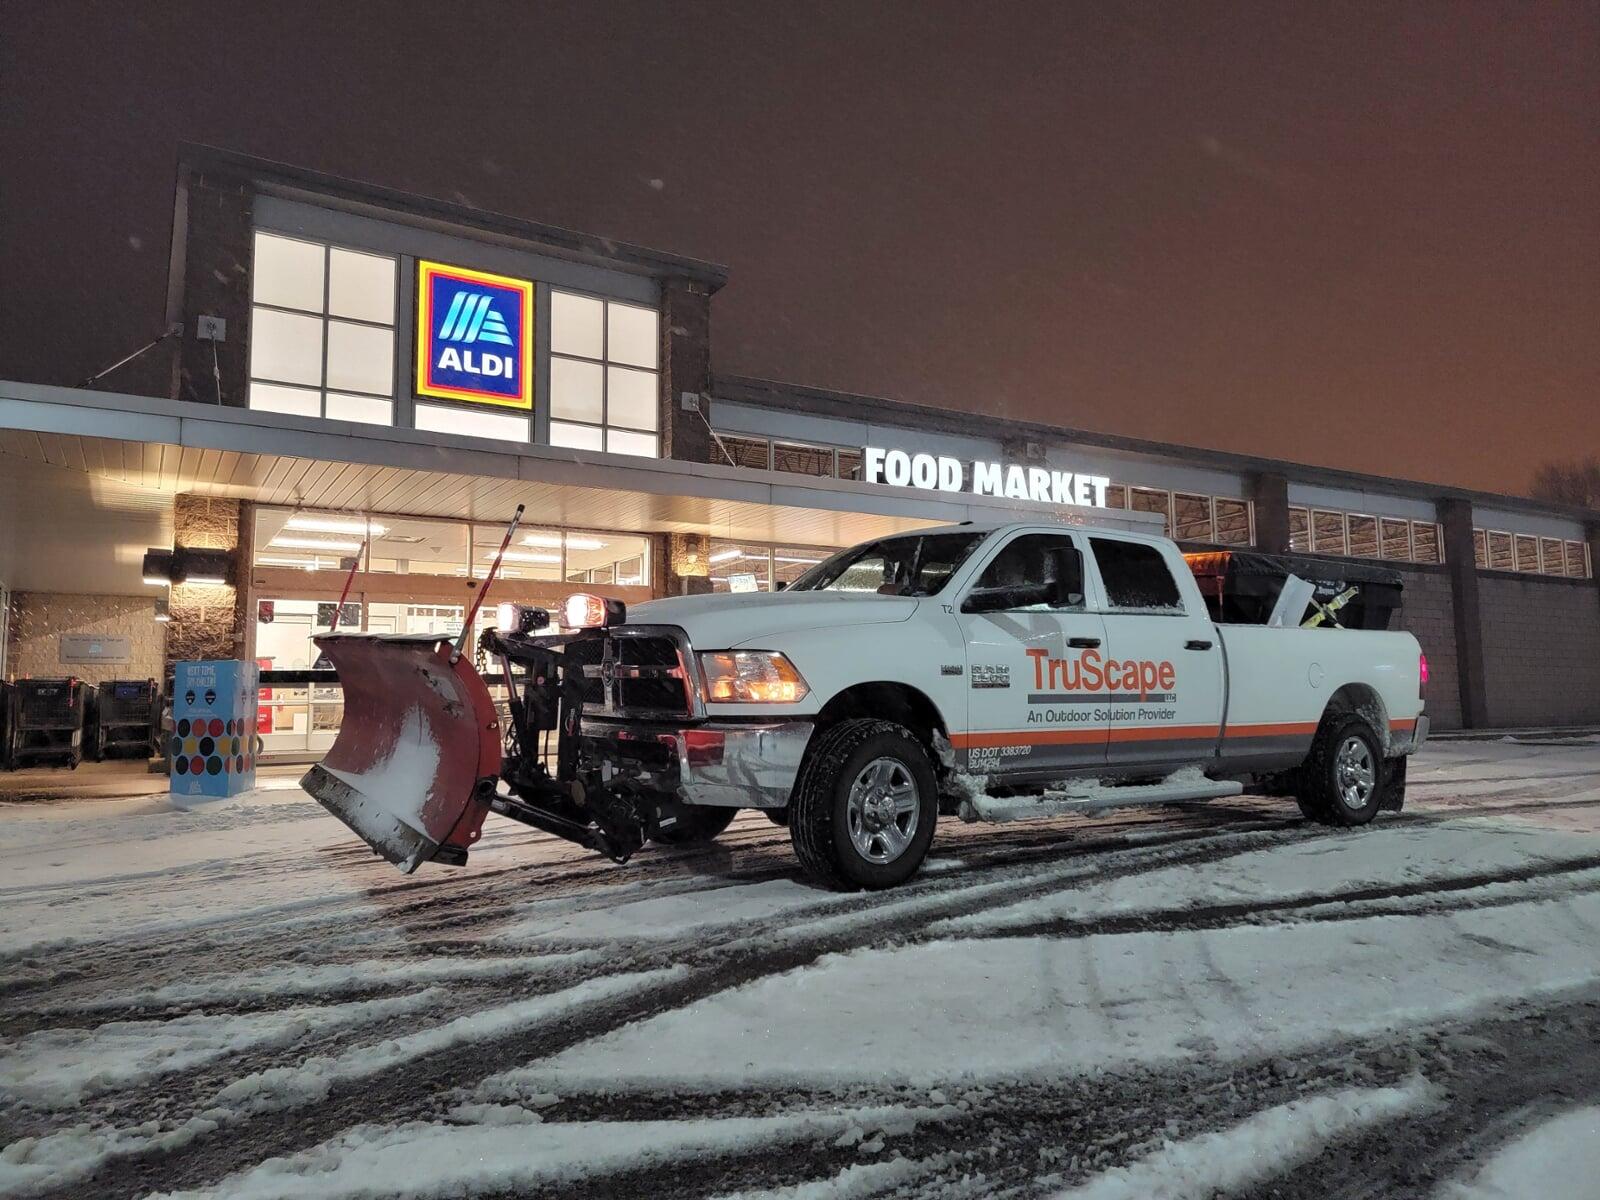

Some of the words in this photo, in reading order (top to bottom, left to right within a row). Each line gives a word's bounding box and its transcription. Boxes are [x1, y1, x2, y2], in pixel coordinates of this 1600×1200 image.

[438, 347, 513, 379] ALDI
[864, 447, 963, 492] FOOD
[972, 460, 1111, 509] MARKET
[941, 604, 954, 614] T2
[1025, 648, 1176, 703] TruScape
[1164, 694, 1176, 702] LLC
[1027, 710, 1043, 723] An
[1045, 709, 1091, 722] Outdoor
[1094, 708, 1136, 721] Solution
[1137, 707, 1176, 721] Provider
[968, 748, 980, 759] US
[981, 747, 1000, 758] DOT
